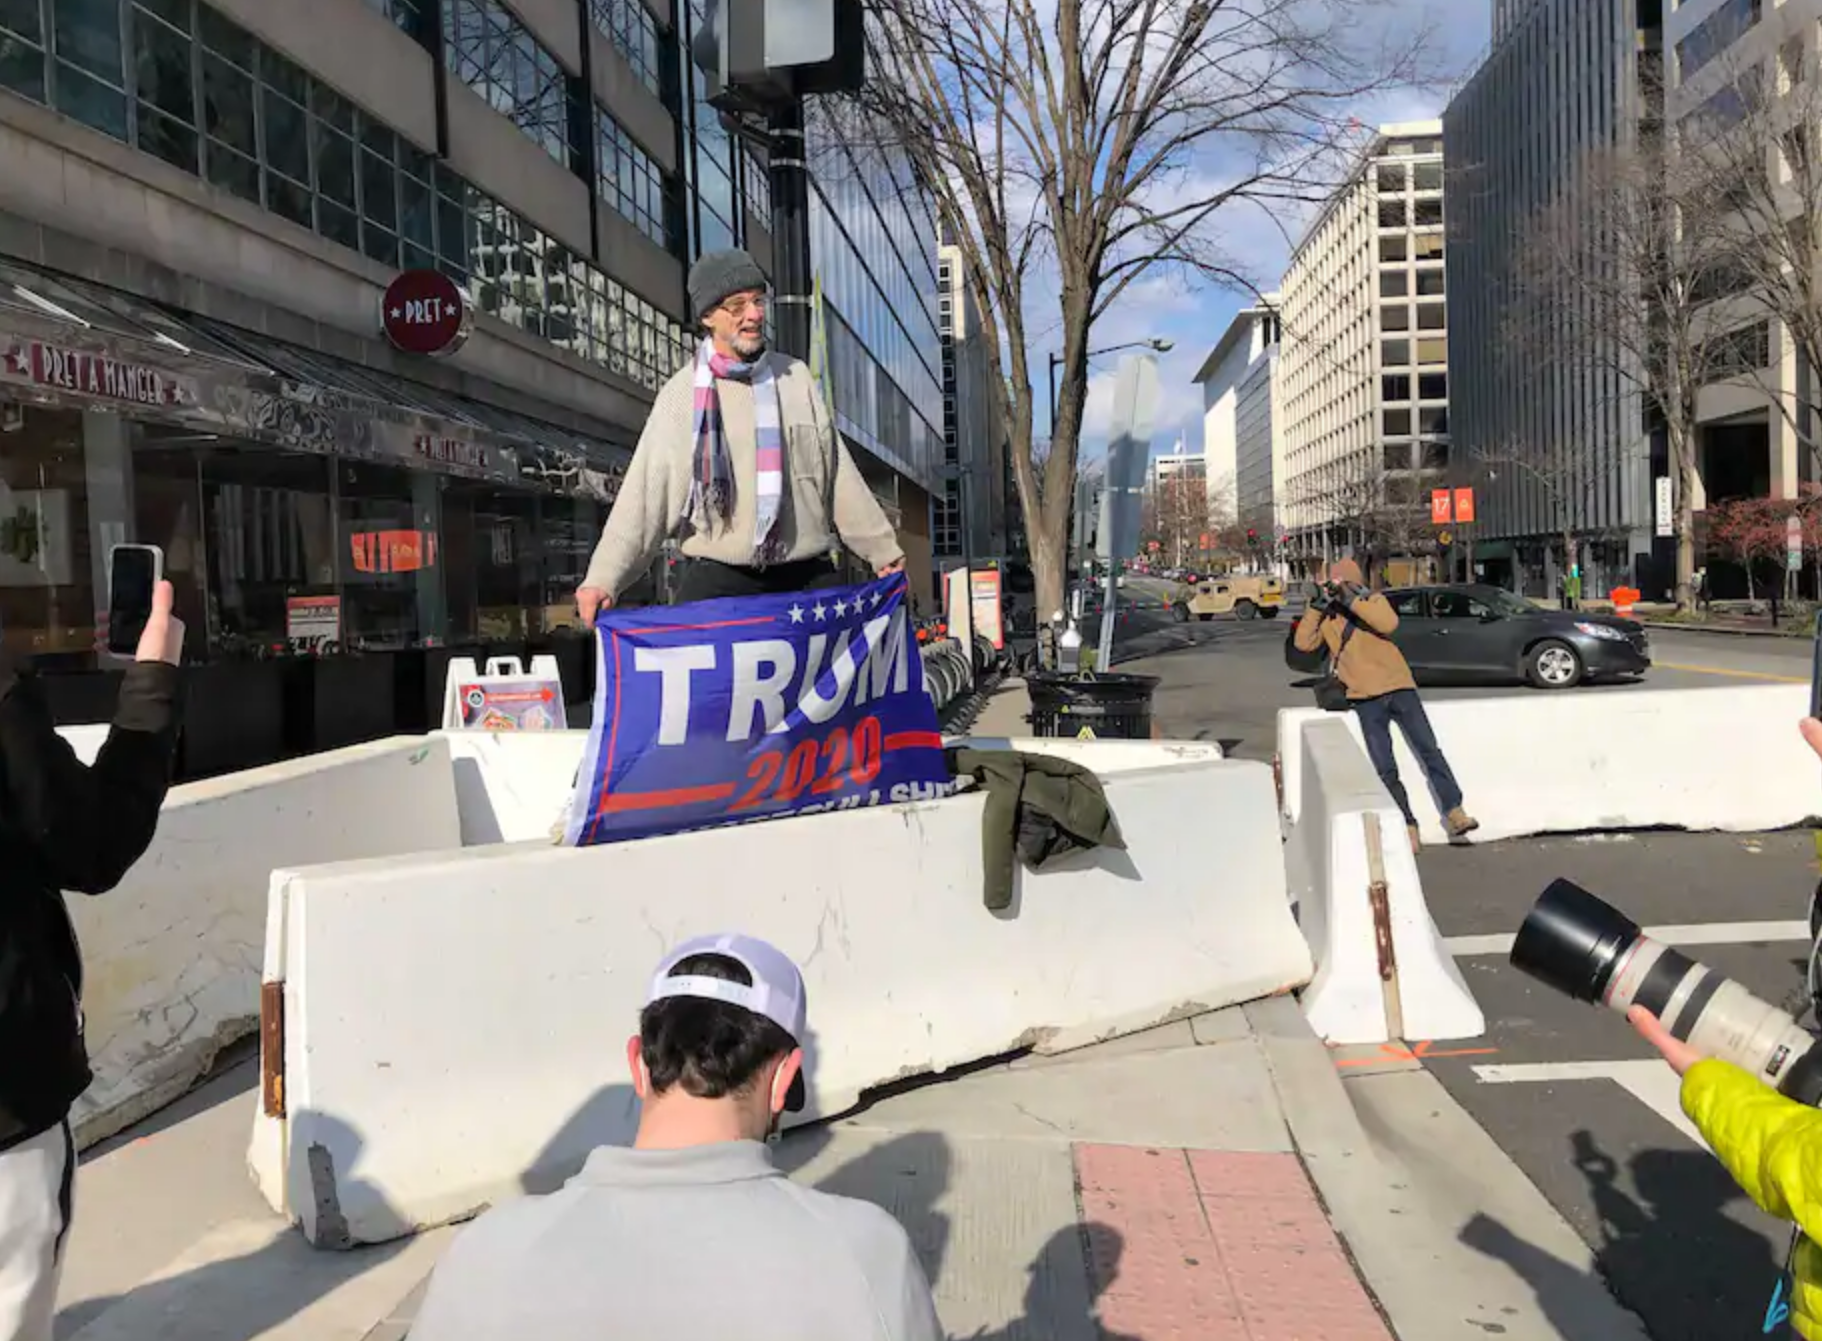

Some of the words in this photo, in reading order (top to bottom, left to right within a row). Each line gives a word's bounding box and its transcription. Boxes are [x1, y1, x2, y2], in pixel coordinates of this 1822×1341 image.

[405, 297, 441, 324] PRET
[43, 347, 82, 390] PRET
[104, 358, 164, 405] MANGER
[1433, 497, 1450, 512] 17
[634, 604, 931, 746] TRUM
[727, 716, 881, 814] 2020
